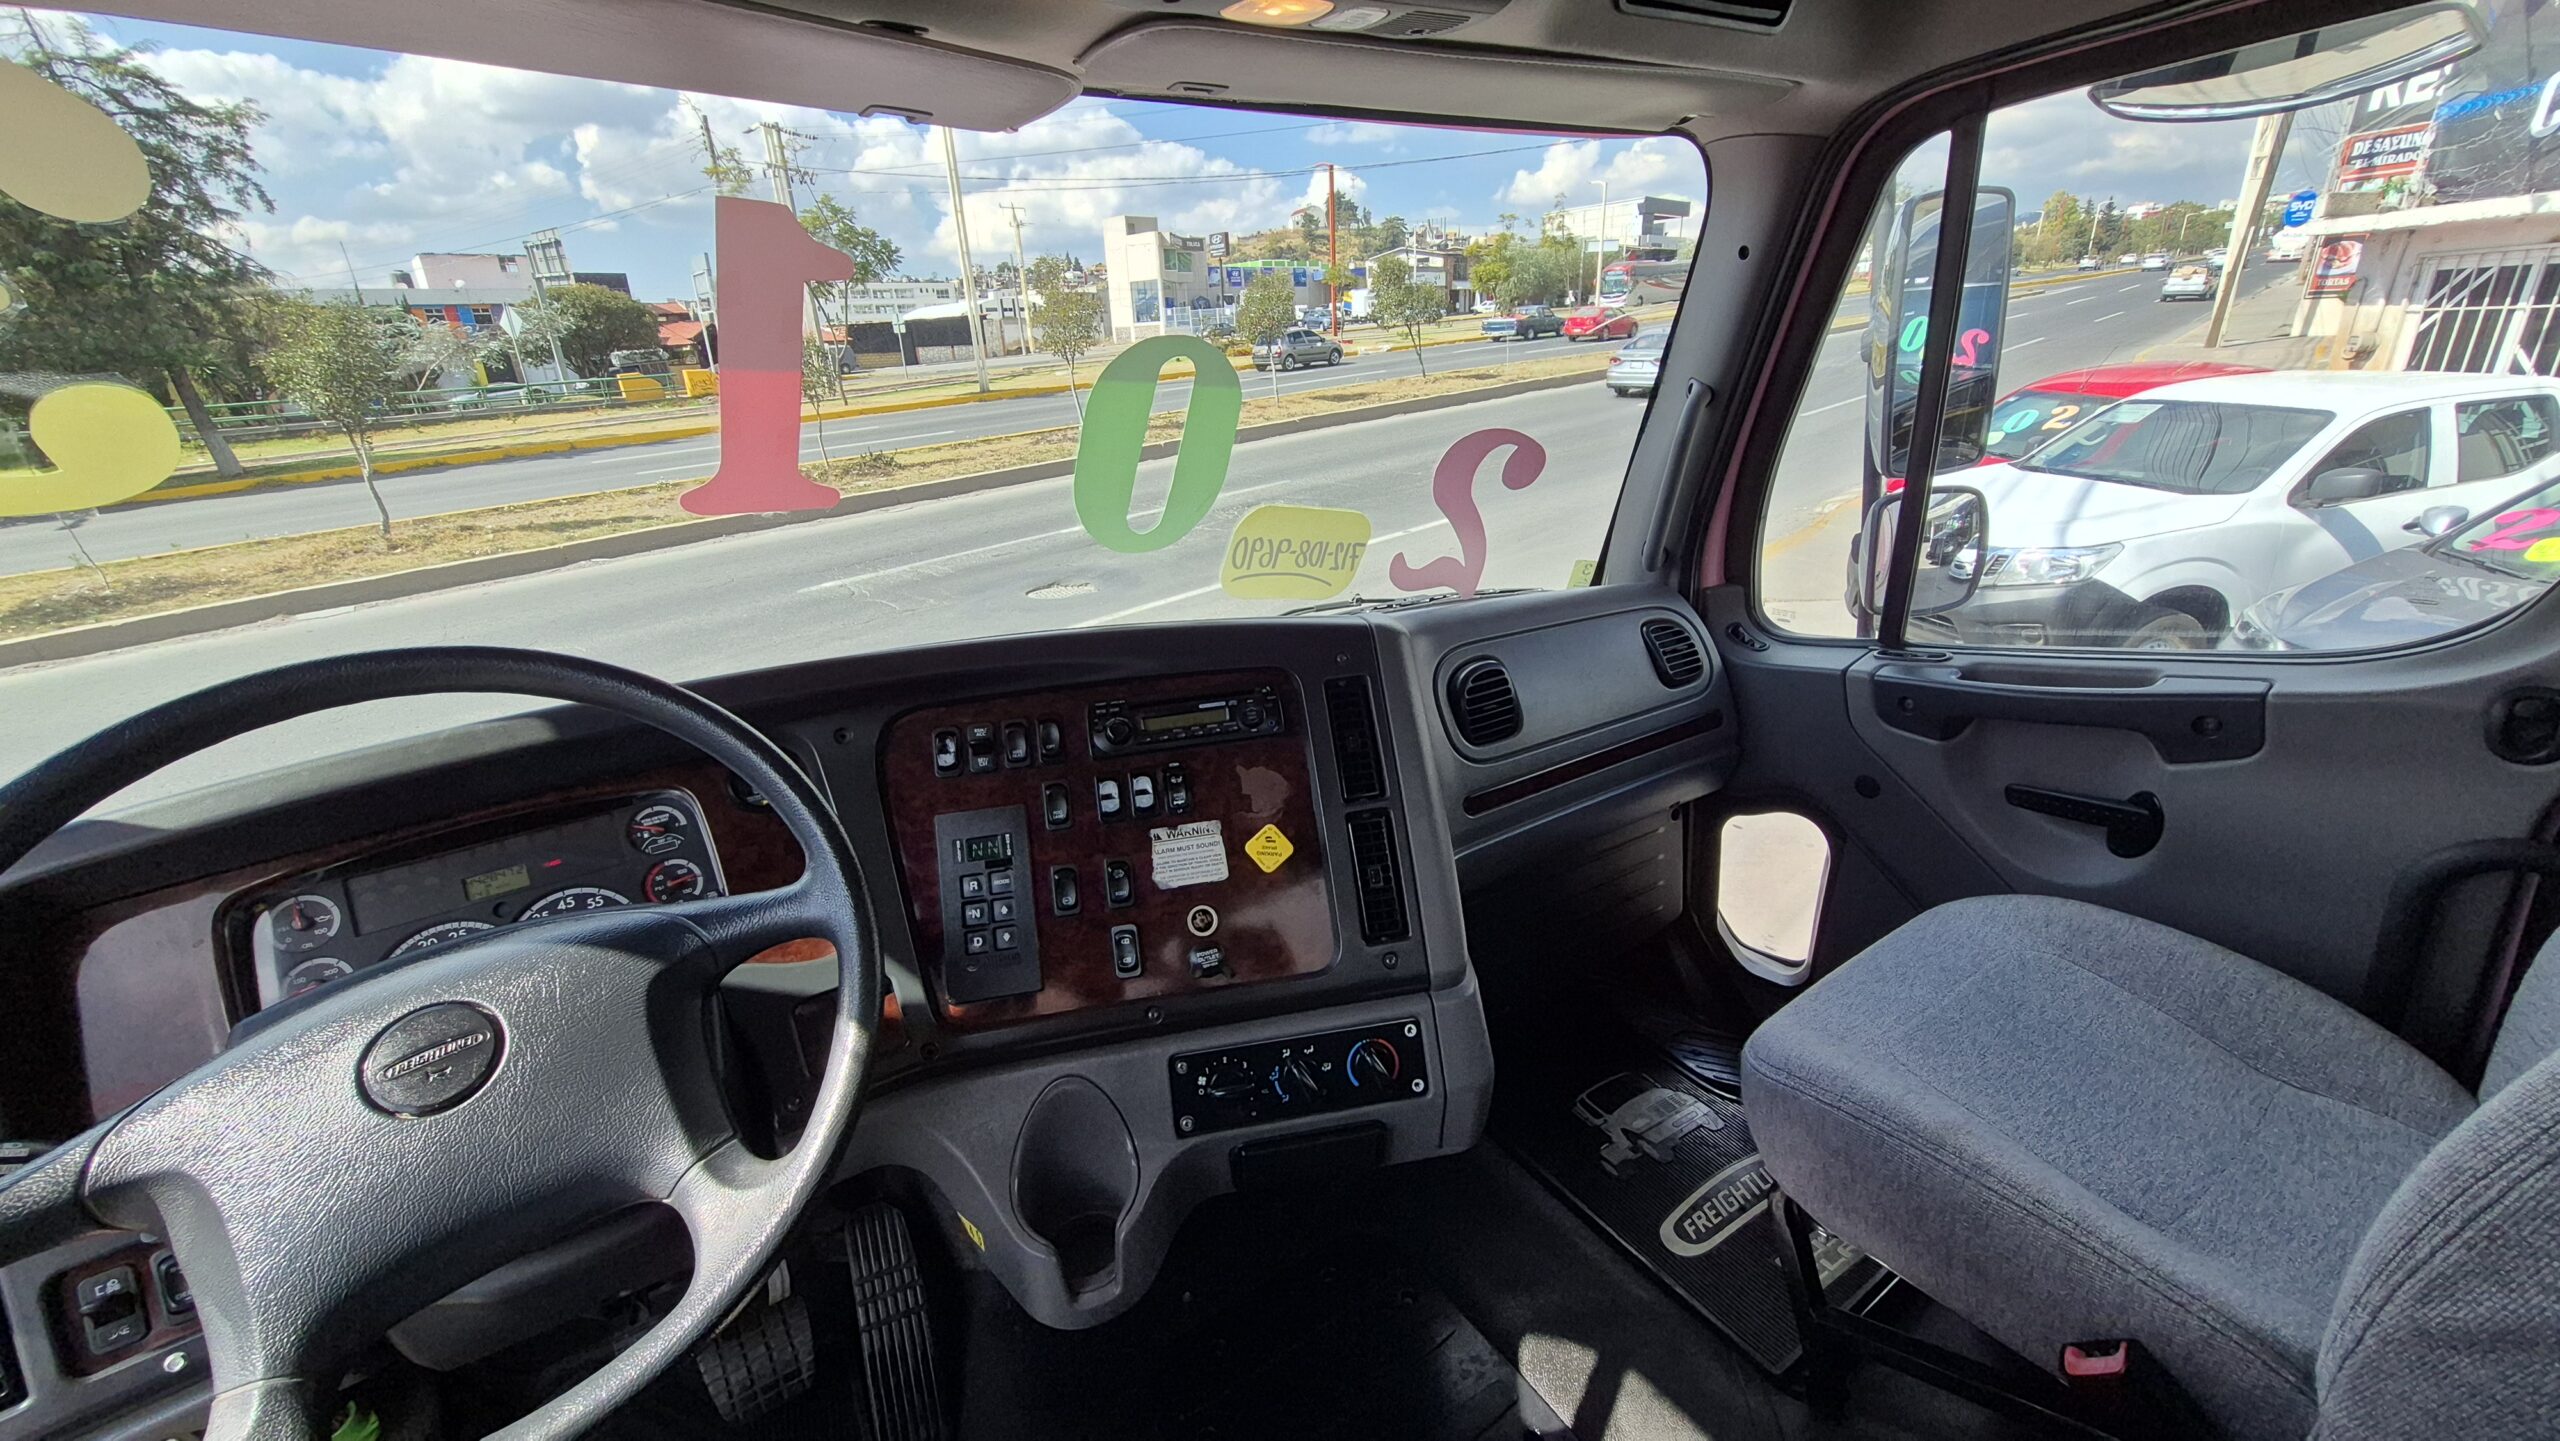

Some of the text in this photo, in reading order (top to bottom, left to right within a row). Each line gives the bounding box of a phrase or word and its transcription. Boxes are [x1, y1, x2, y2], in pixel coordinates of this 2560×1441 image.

[2318, 277, 2350, 286] TORTAS
[1166, 826, 1215, 840] WARNIN
[1176, 844, 1195, 852] MUST
[969, 881, 978, 891] R
[557, 895, 605, 911] 45 55
[313, 926, 328, 935] 100
[973, 936, 983, 947] D
[1196, 948, 1219, 958] POWER
[1197, 953, 1220, 963] OUTLET
[323, 968, 339, 976] 200
